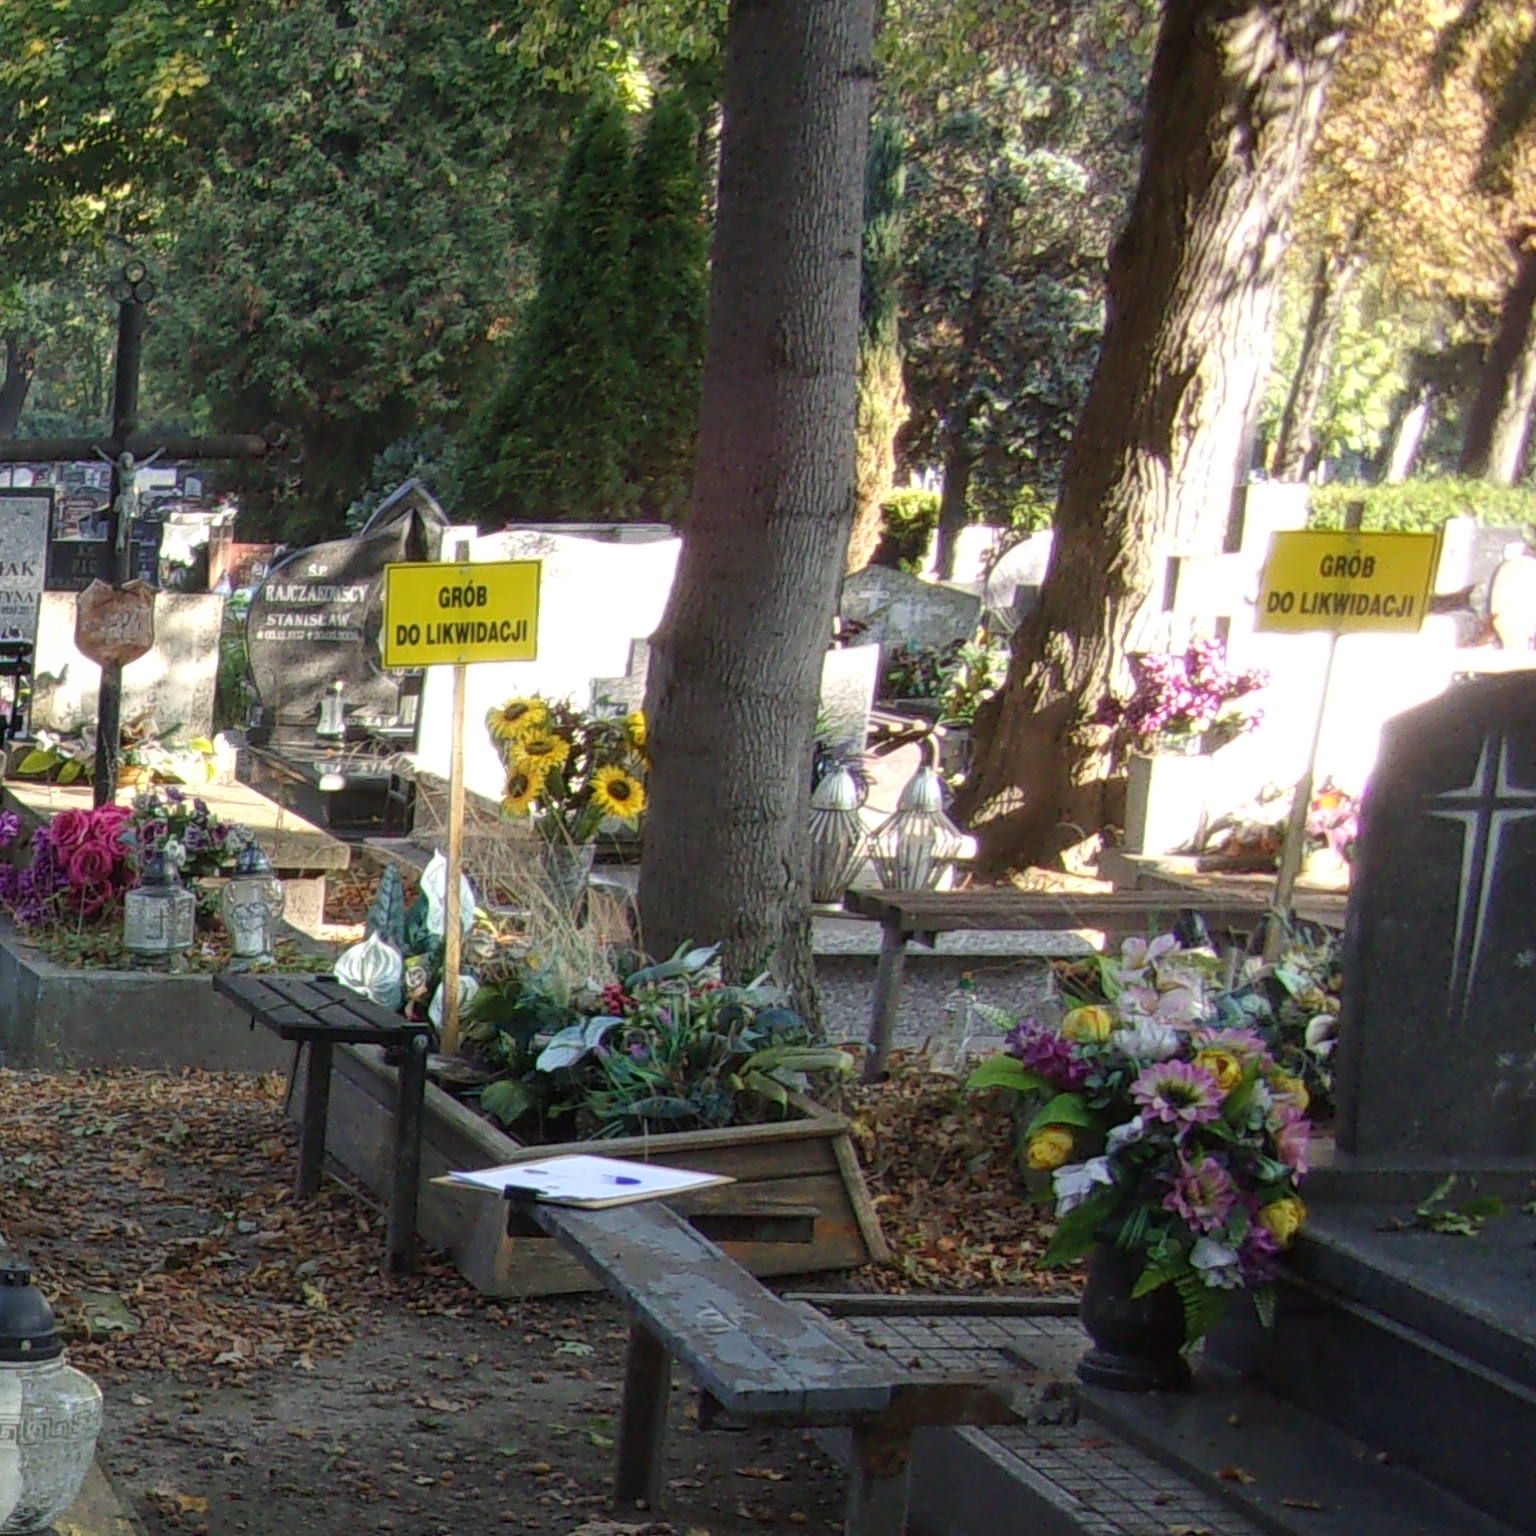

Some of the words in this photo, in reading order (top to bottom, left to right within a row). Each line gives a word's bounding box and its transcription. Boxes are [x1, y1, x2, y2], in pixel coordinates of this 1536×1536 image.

[1319, 551, 1376, 579] GRÓB
[439, 580, 488, 608] GRÓB
[1267, 591, 1294, 613] DO
[1300, 592, 1415, 617] LIKWIDACJI
[396, 624, 421, 646] DO
[427, 621, 528, 645] LIKWIDACJI
